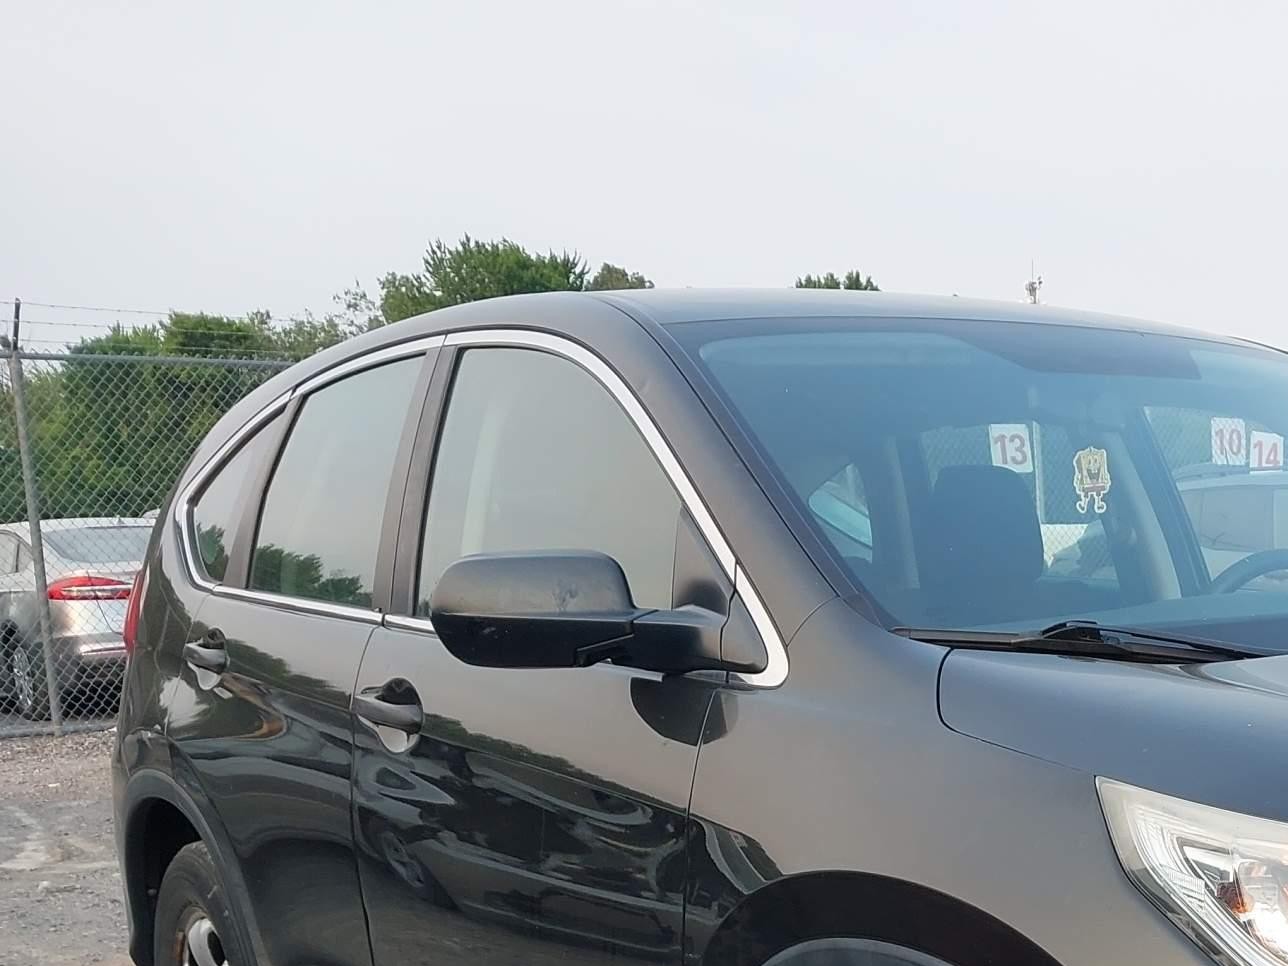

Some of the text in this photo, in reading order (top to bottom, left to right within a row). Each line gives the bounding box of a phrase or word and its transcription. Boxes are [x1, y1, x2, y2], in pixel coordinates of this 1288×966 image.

[993, 433, 1028, 466] 13
[1215, 428, 1242, 457] 10
[1253, 439, 1282, 468] 14
